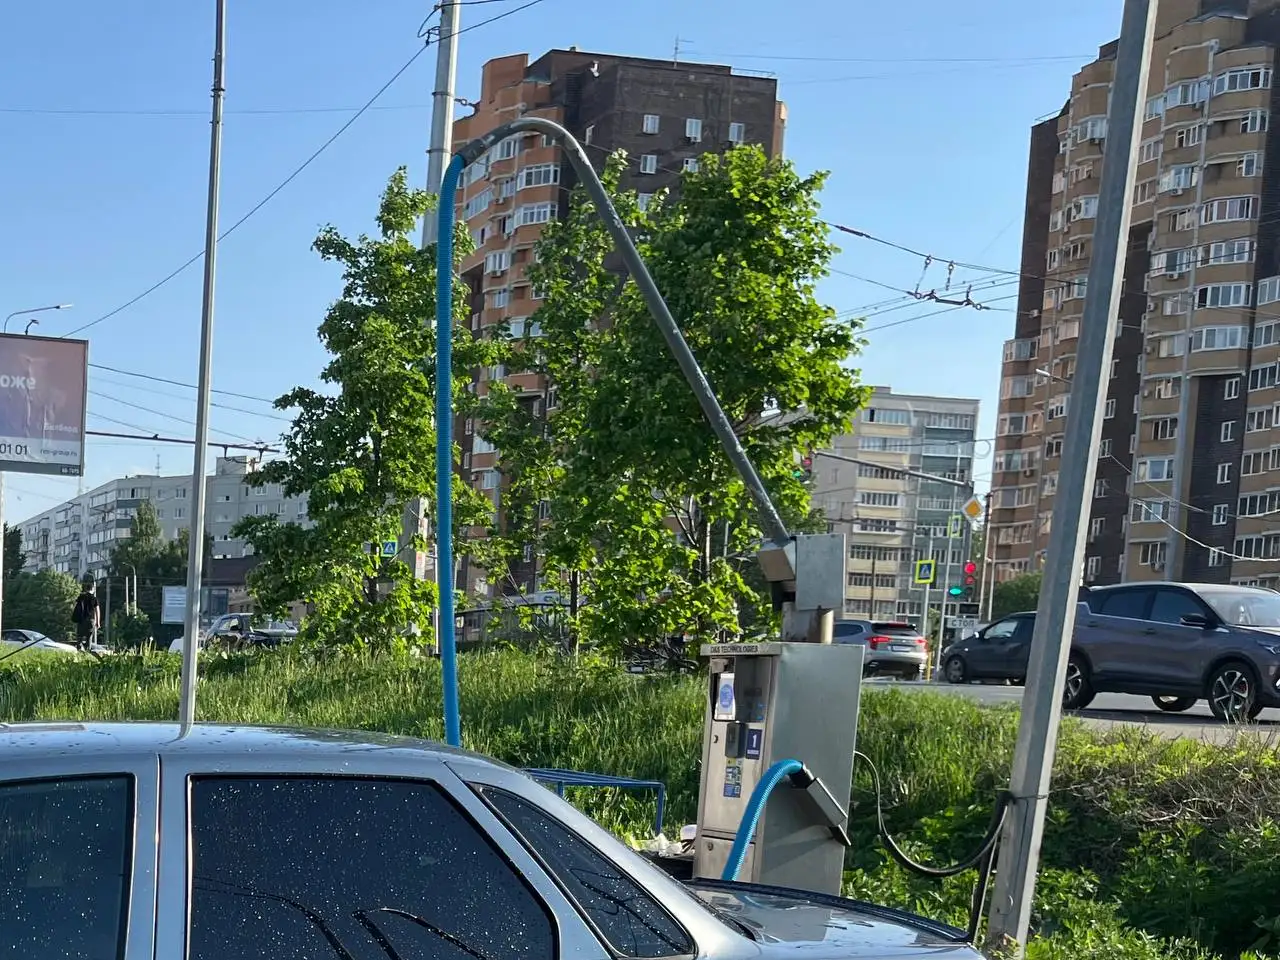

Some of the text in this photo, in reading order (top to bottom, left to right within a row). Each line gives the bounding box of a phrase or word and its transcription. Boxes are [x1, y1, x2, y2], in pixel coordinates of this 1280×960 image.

[0, 443, 12, 455] 01
[15, 444, 28, 455] 01
[752, 734, 757, 749] 1
